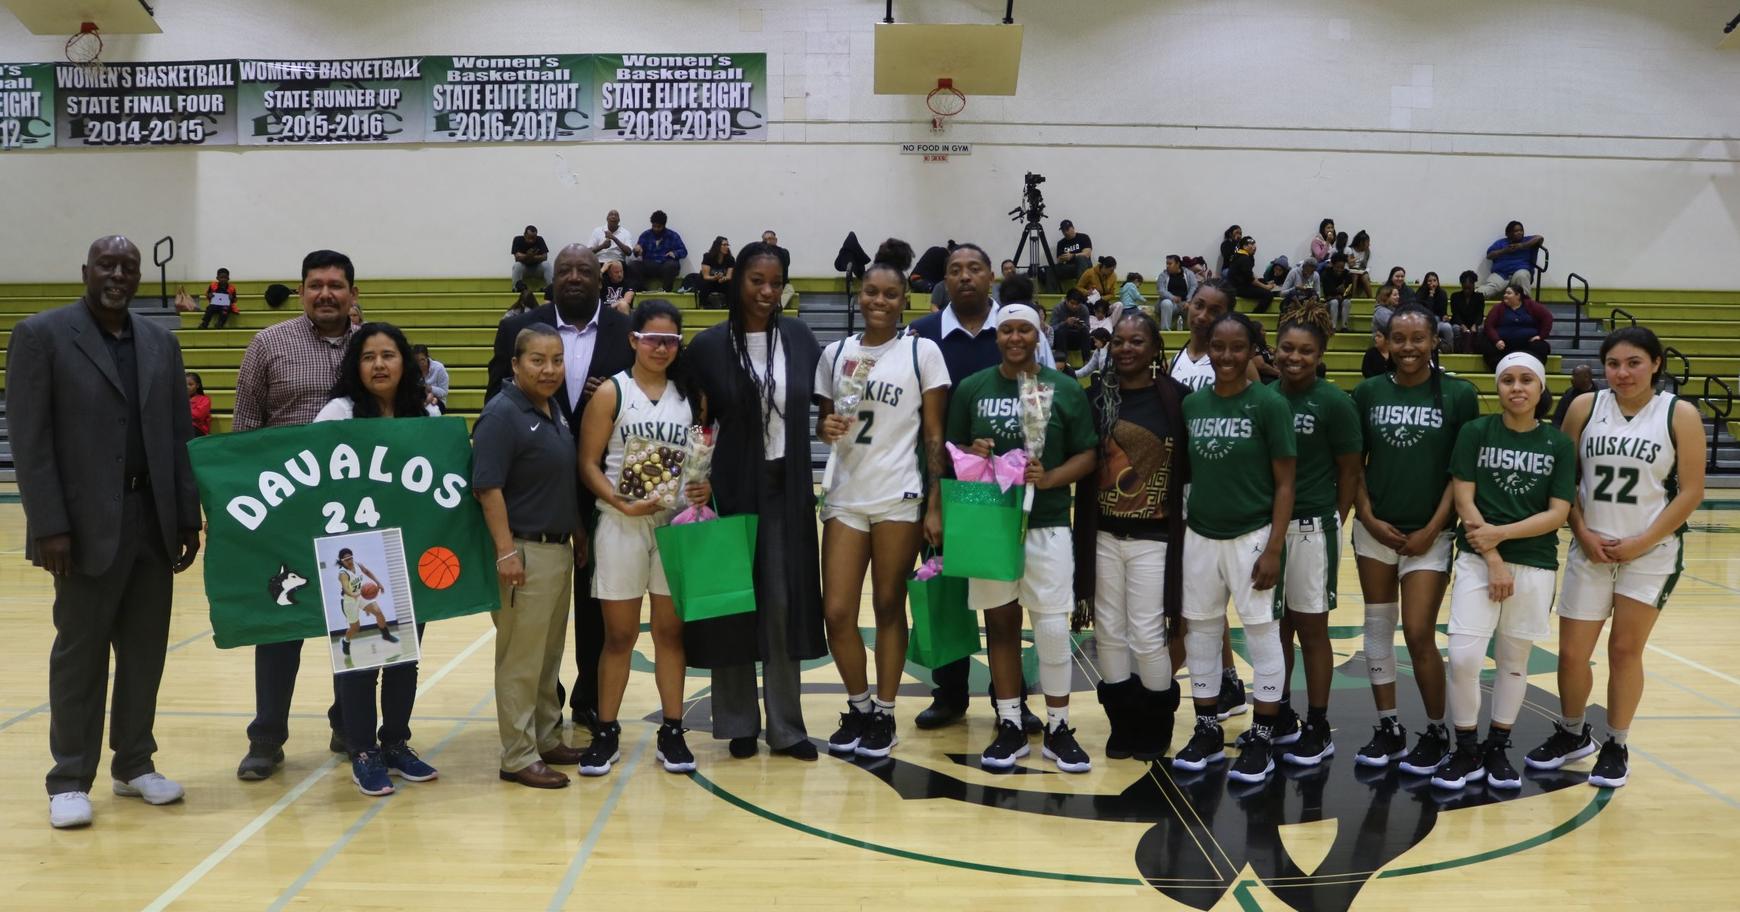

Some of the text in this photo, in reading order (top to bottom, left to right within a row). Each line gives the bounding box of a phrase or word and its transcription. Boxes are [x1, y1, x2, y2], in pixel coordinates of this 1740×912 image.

[239, 59, 420, 80] WOMEN'S BASKETBALL
[452, 56, 559, 68] Women's
[622, 54, 732, 67] Women's
[56, 63, 235, 88] WOMEN'S BASKETBALL
[447, 69, 570, 82] Basketball
[616, 68, 743, 80] Basketball
[66, 94, 224, 114] STATE FINAL FOUR
[264, 88, 400, 109] STATE RUNNER UP
[432, 83, 579, 110] STATE ELITE EIGHT
[601, 82, 752, 110] STATE ELITE EIGHT
[88, 120, 205, 142] 2014-2015
[281, 113, 384, 137] 2015-2016
[455, 112, 558, 141] 2016-2017
[623, 110, 732, 140] 2018-2019
[903, 144, 969, 152] NO FOOD IN GYM
[861, 380, 904, 407] KIES
[977, 397, 1025, 418] HUSK
[1369, 405, 1443, 428] HUSKIES
[620, 421, 689, 446] HUSKIES
[855, 410, 874, 445] 2
[1188, 417, 1253, 438] HUSKIES
[1477, 446, 1555, 476] HUSKIES
[1586, 435, 1662, 464] HUSKIES
[226, 443, 467, 531] DAVALOS
[1593, 464, 1640, 505] 22
[322, 496, 381, 534] 24
